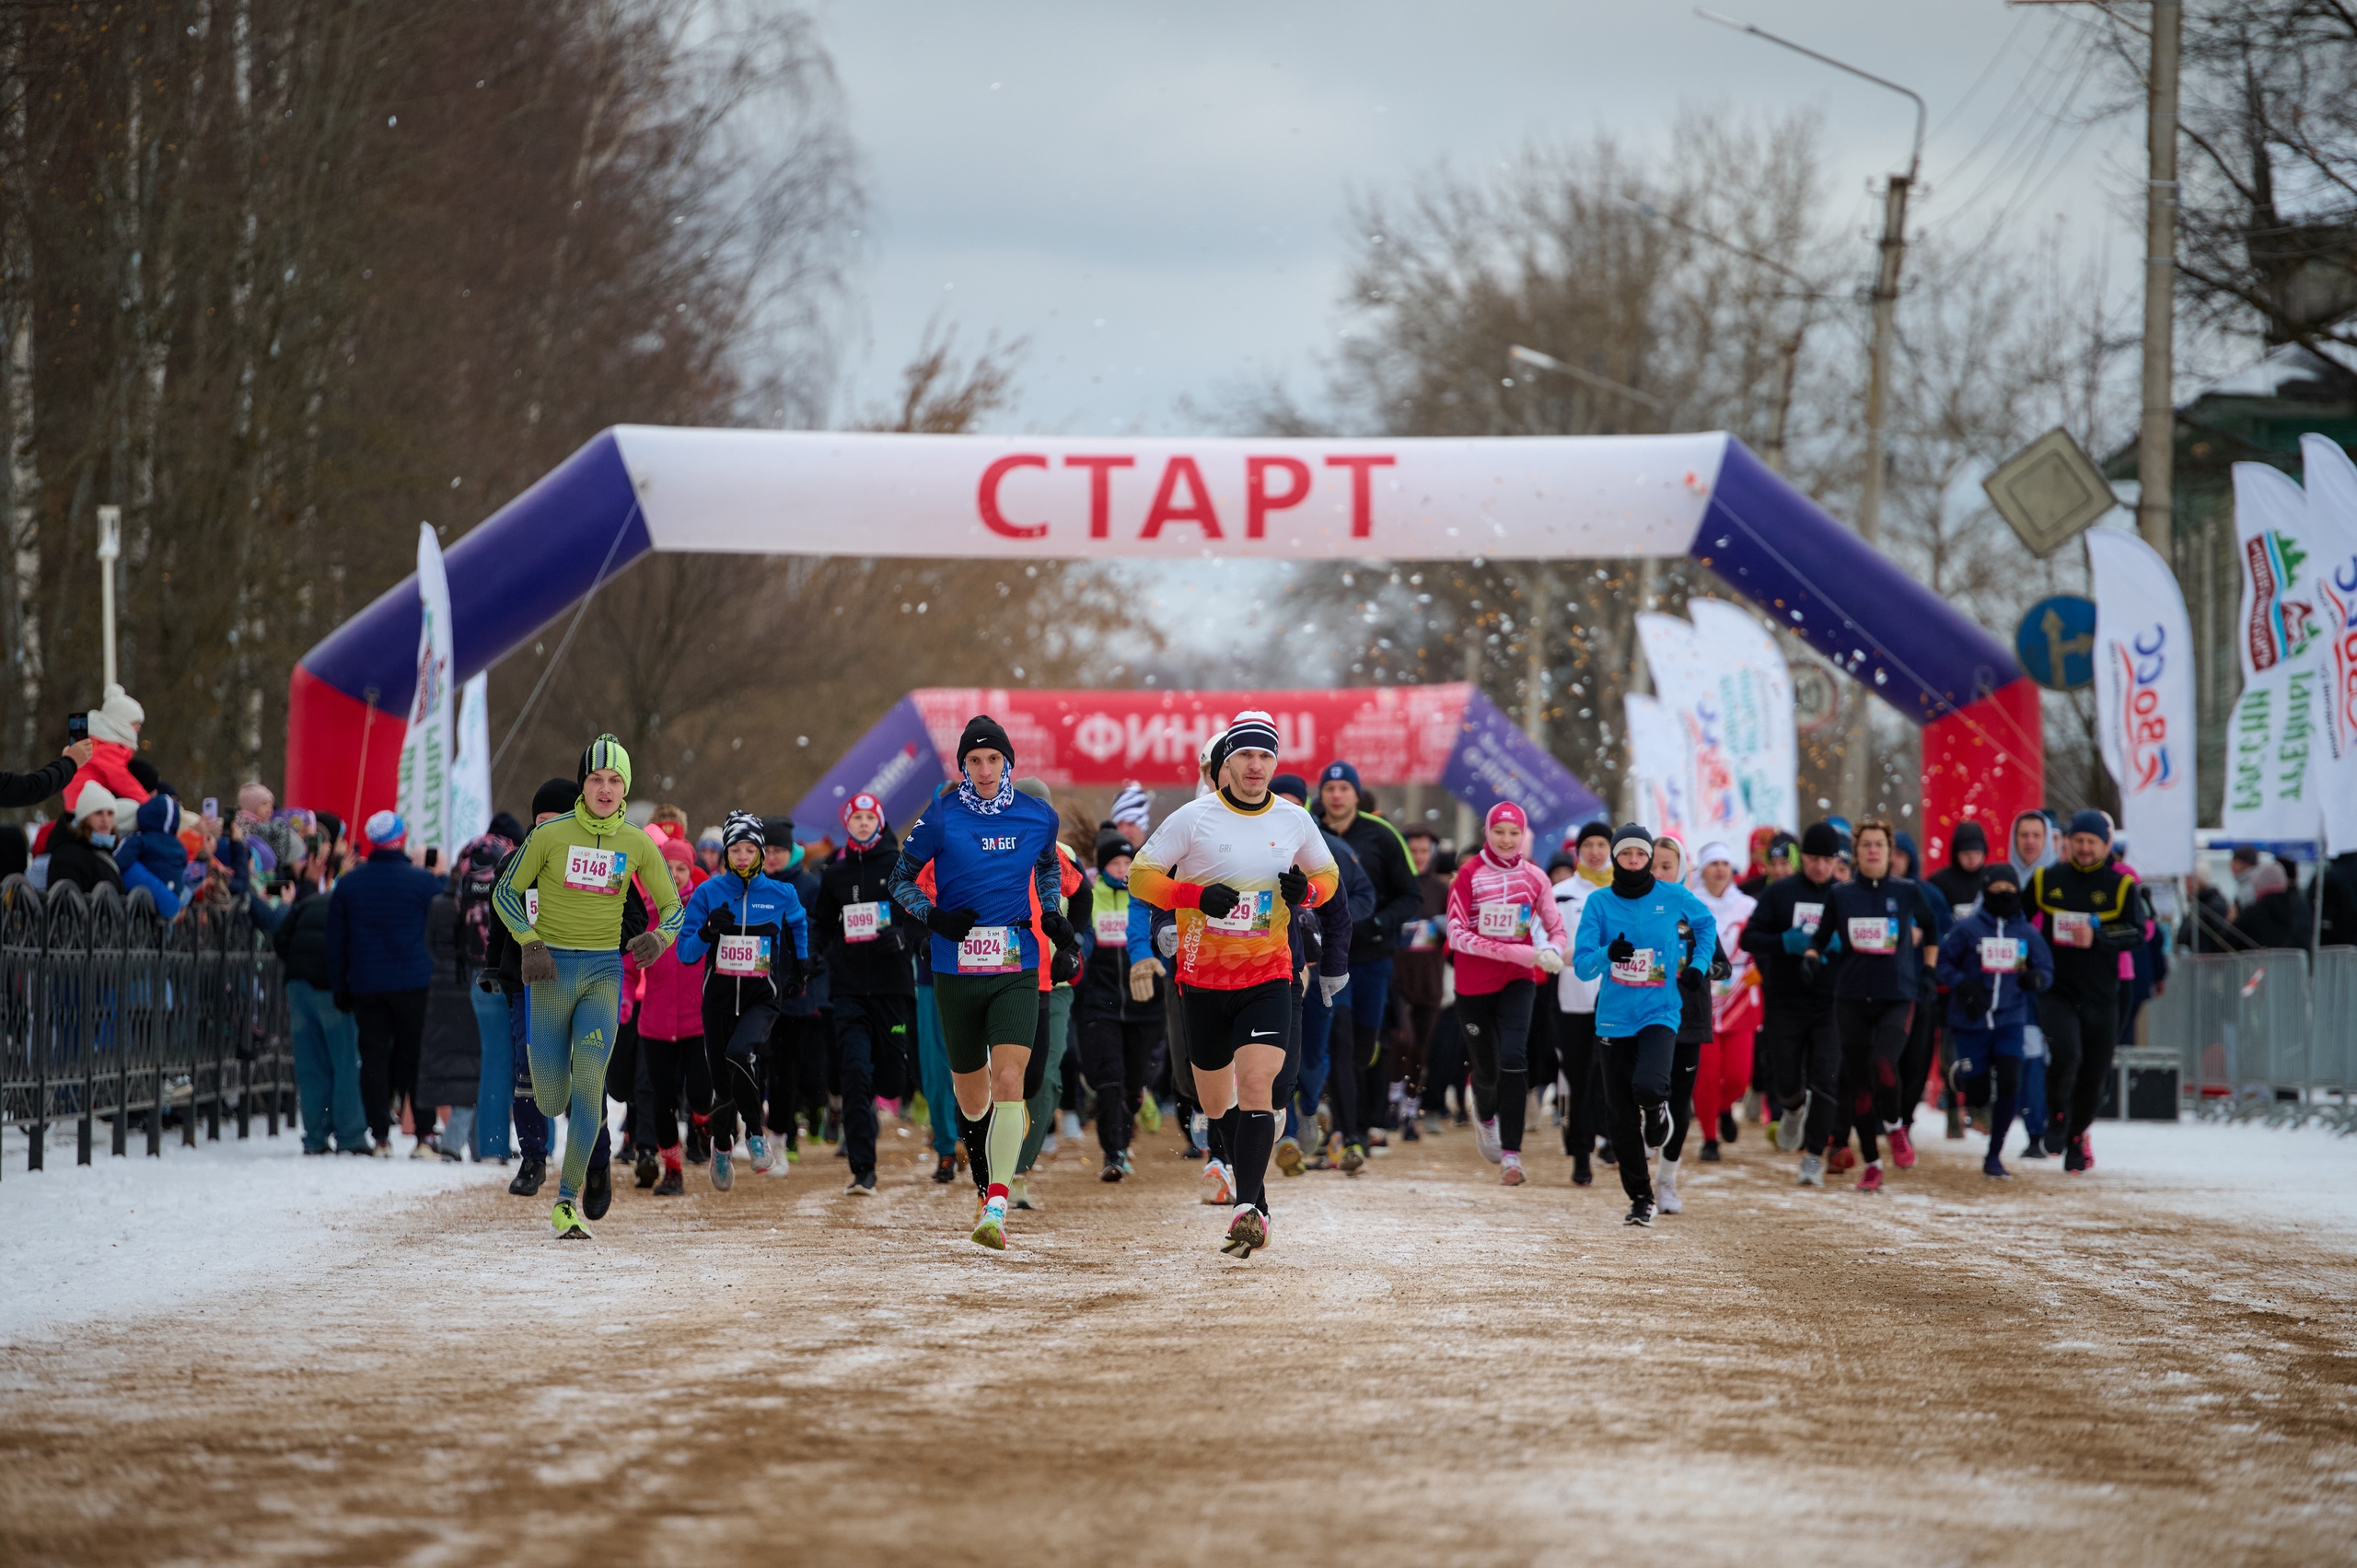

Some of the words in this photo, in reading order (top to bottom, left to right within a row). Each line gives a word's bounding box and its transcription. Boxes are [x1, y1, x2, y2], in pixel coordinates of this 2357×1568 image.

[976, 453, 1397, 540] СТАРТ
[571, 857, 607, 877] 5148
[847, 912, 873, 928] 5099
[1483, 912, 1513, 927] 5121
[720, 946, 753, 961] 5058
[963, 938, 1001, 956] 5024
